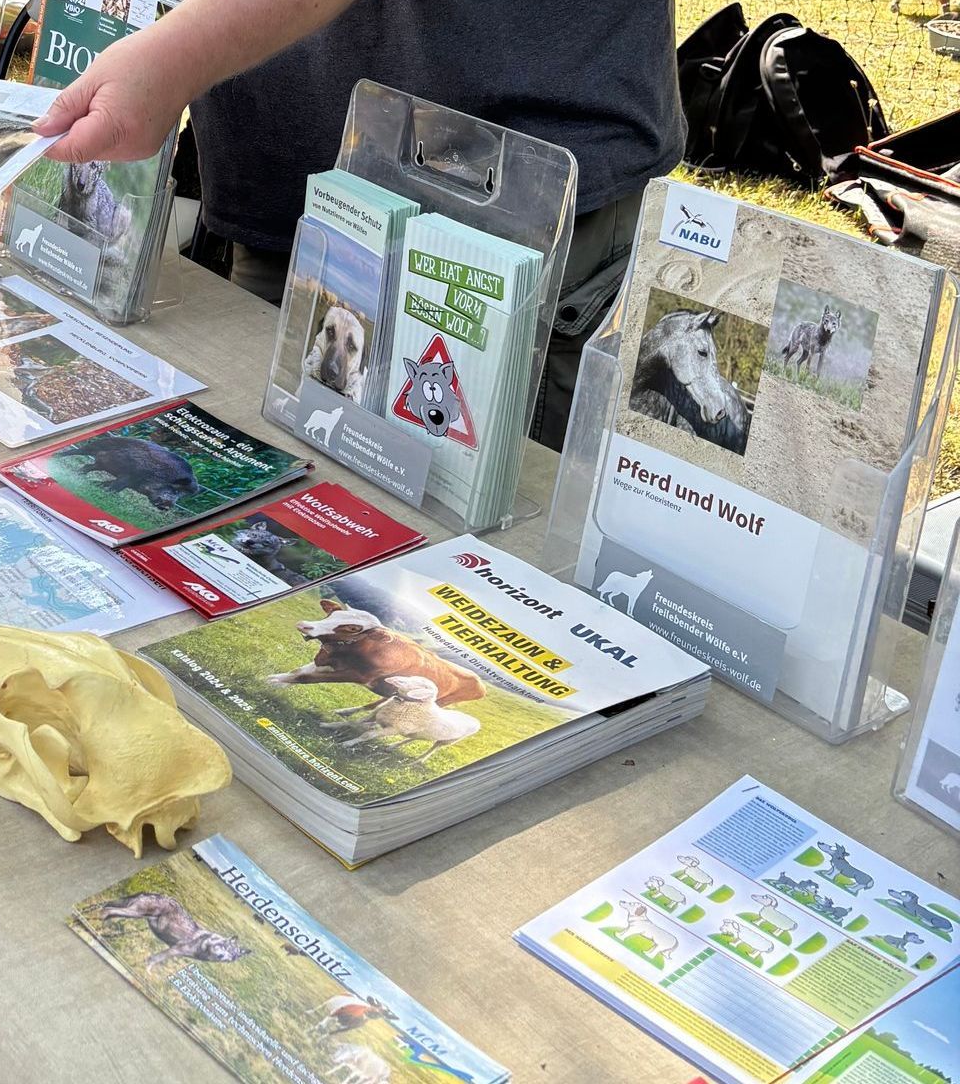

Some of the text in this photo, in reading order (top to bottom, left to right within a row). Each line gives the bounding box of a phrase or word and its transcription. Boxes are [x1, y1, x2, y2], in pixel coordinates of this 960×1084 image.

[45, 30, 101, 75] BIO
[314, 186, 382, 231] Vorbeugender Schutz
[322, 205, 346, 222] Nutztieren
[679, 228, 721, 249] NABU
[414, 253, 500, 295] WER HAT ANGST
[63, 311, 94, 332] FORSCHUNG
[453, 289, 483, 319] VORM
[164, 412, 276, 472] schlagstarkes Argument
[176, 407, 230, 441] Elektrozaun
[235, 442, 254, 453] ein
[343, 423, 383, 452] Freundeskreis
[338, 448, 414, 498] www.freundeskreis-wolf.de
[341, 432, 406, 477] freilebender Wölfe e.V.
[282, 501, 326, 529] mit Elektrozaun
[290, 499, 352, 536] Effektive Wolfsabwehr
[300, 493, 379, 538] Wolfsabwehr
[613, 477, 682, 513] Wege zur Koexistenz
[617, 456, 765, 535] Pferd und Wolf
[89, 519, 125, 533] AKO
[182, 581, 220, 602] AKO
[655, 591, 714, 631] Freundeskreis
[436, 586, 565, 671] WEIDEZAUN &
[474, 567, 640, 668] horizont UKAL
[652, 603, 748, 664] freilebender Wölfe e.V.
[423, 626, 545, 703] Hofbedarf & Direktvermarktung
[440, 616, 570, 697] TIERHALTUNG
[649, 621, 761, 692] www.freundeskreis-wolf.de
[171, 649, 253, 712] Katalog 2024 & 2025
[268, 725, 361, 793] animalcare.horizont.com
[221, 865, 352, 981] Herdenschutz
[211, 1000, 229, 1017] zum
[406, 1025, 449, 1056] MCM
